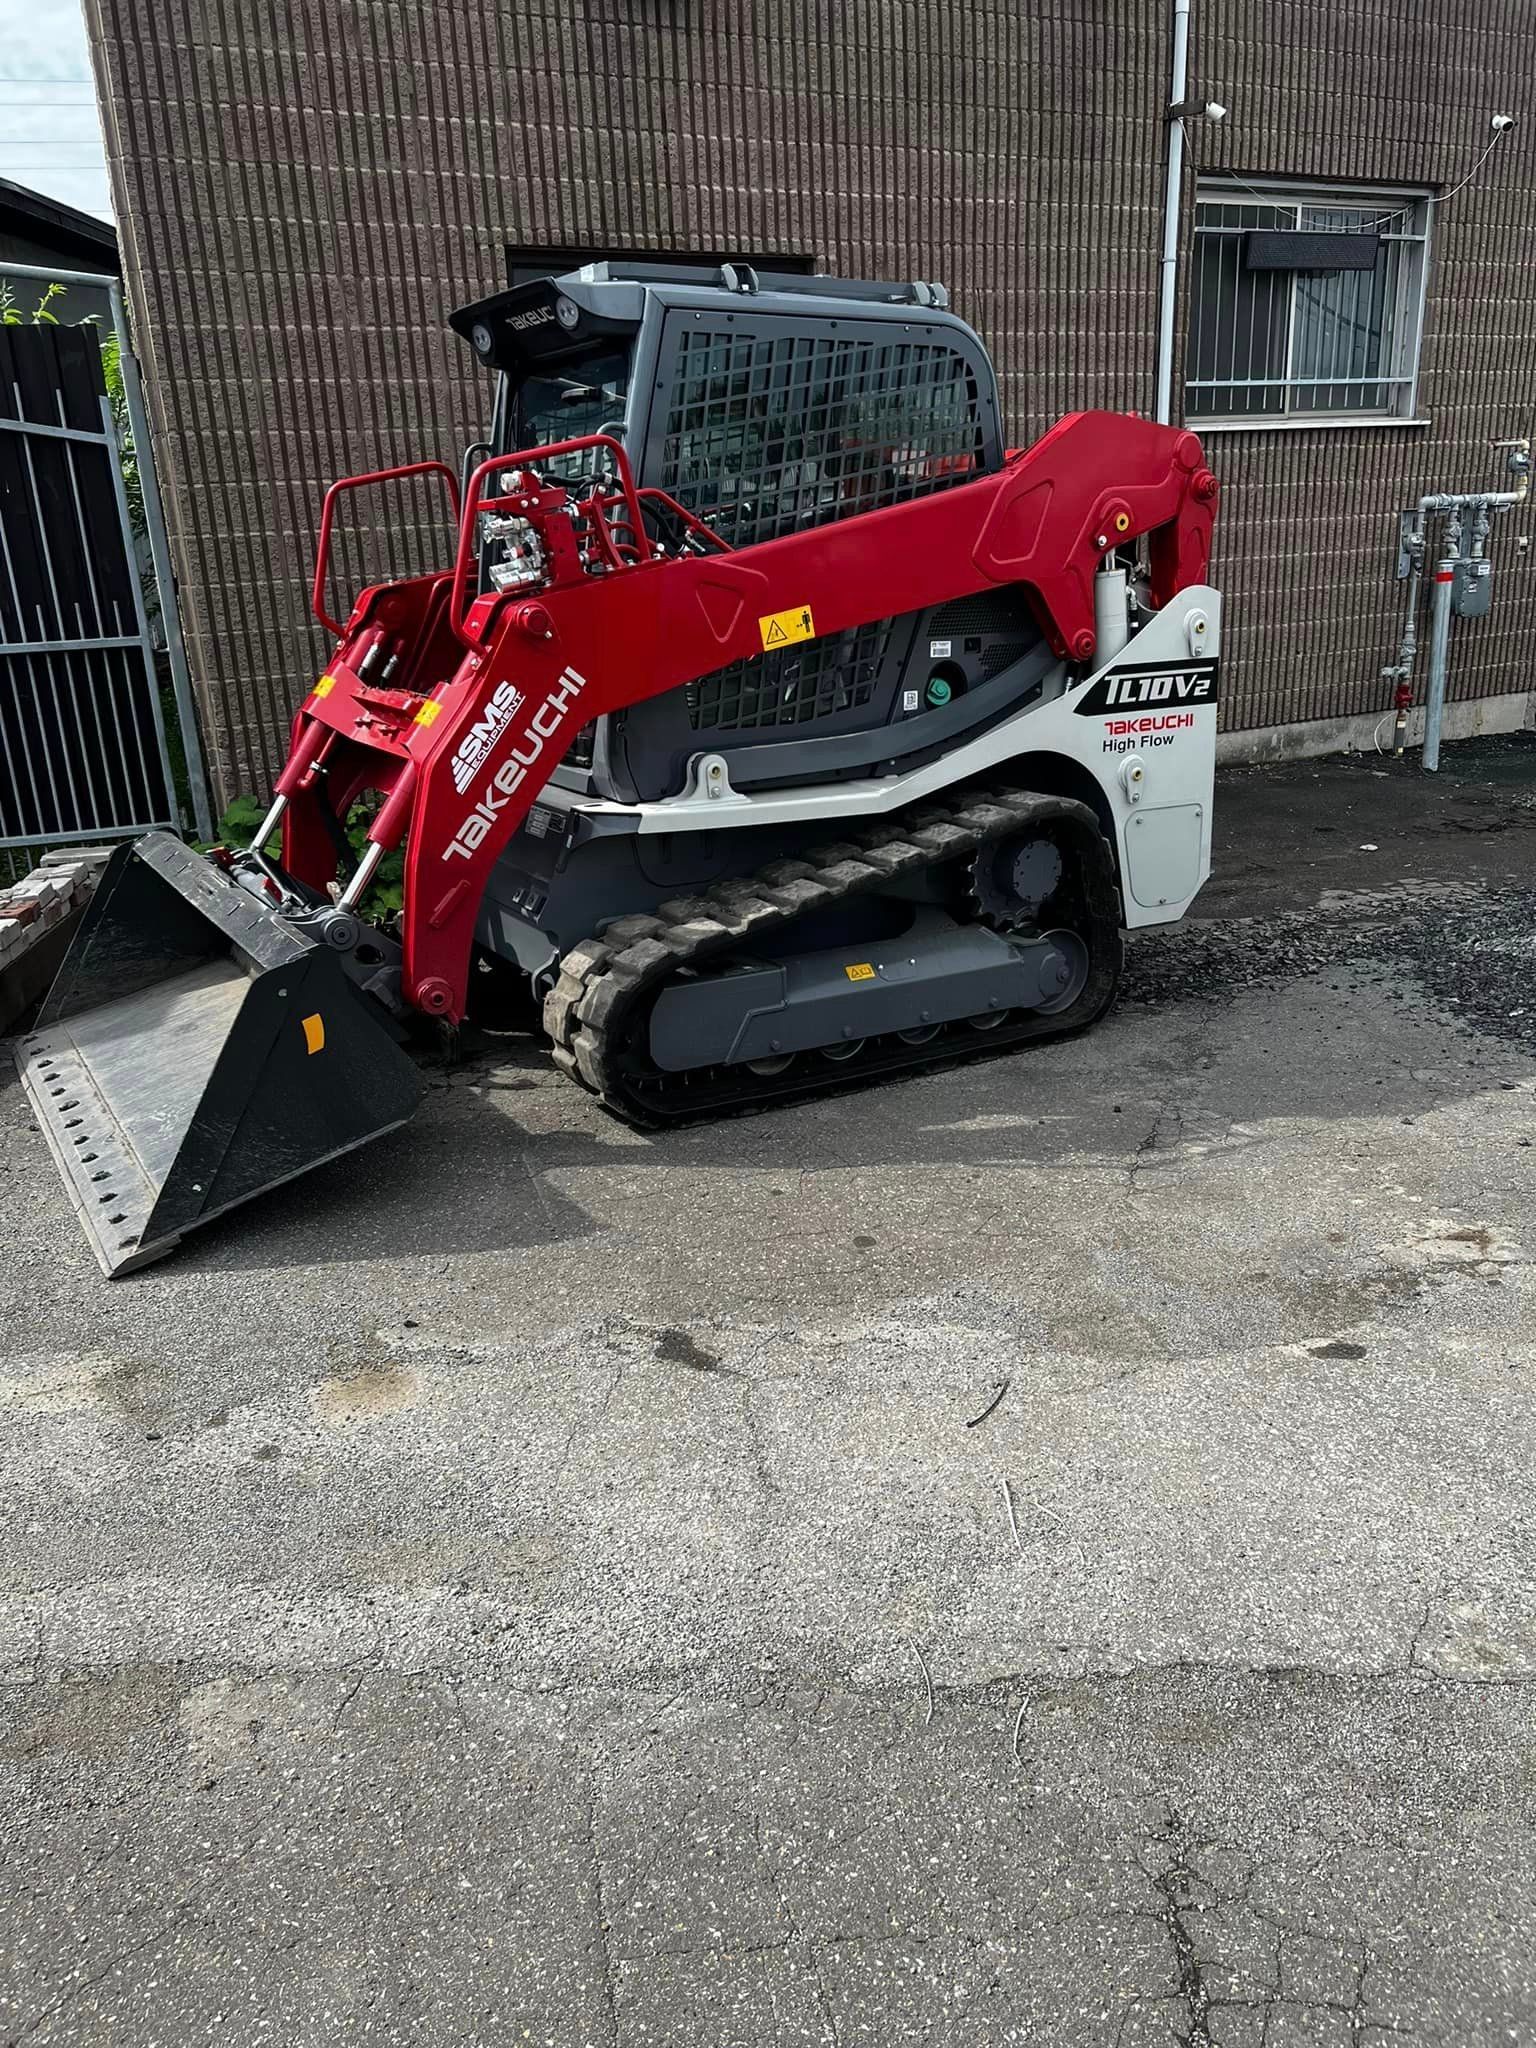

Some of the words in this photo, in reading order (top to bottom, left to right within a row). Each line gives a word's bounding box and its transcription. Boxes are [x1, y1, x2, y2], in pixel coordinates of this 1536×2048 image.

[458, 681, 517, 765] SMS
[471, 691, 524, 769] EQUIPMENT
[1102, 738, 1135, 753] High
[1140, 735, 1174, 748] Flow
